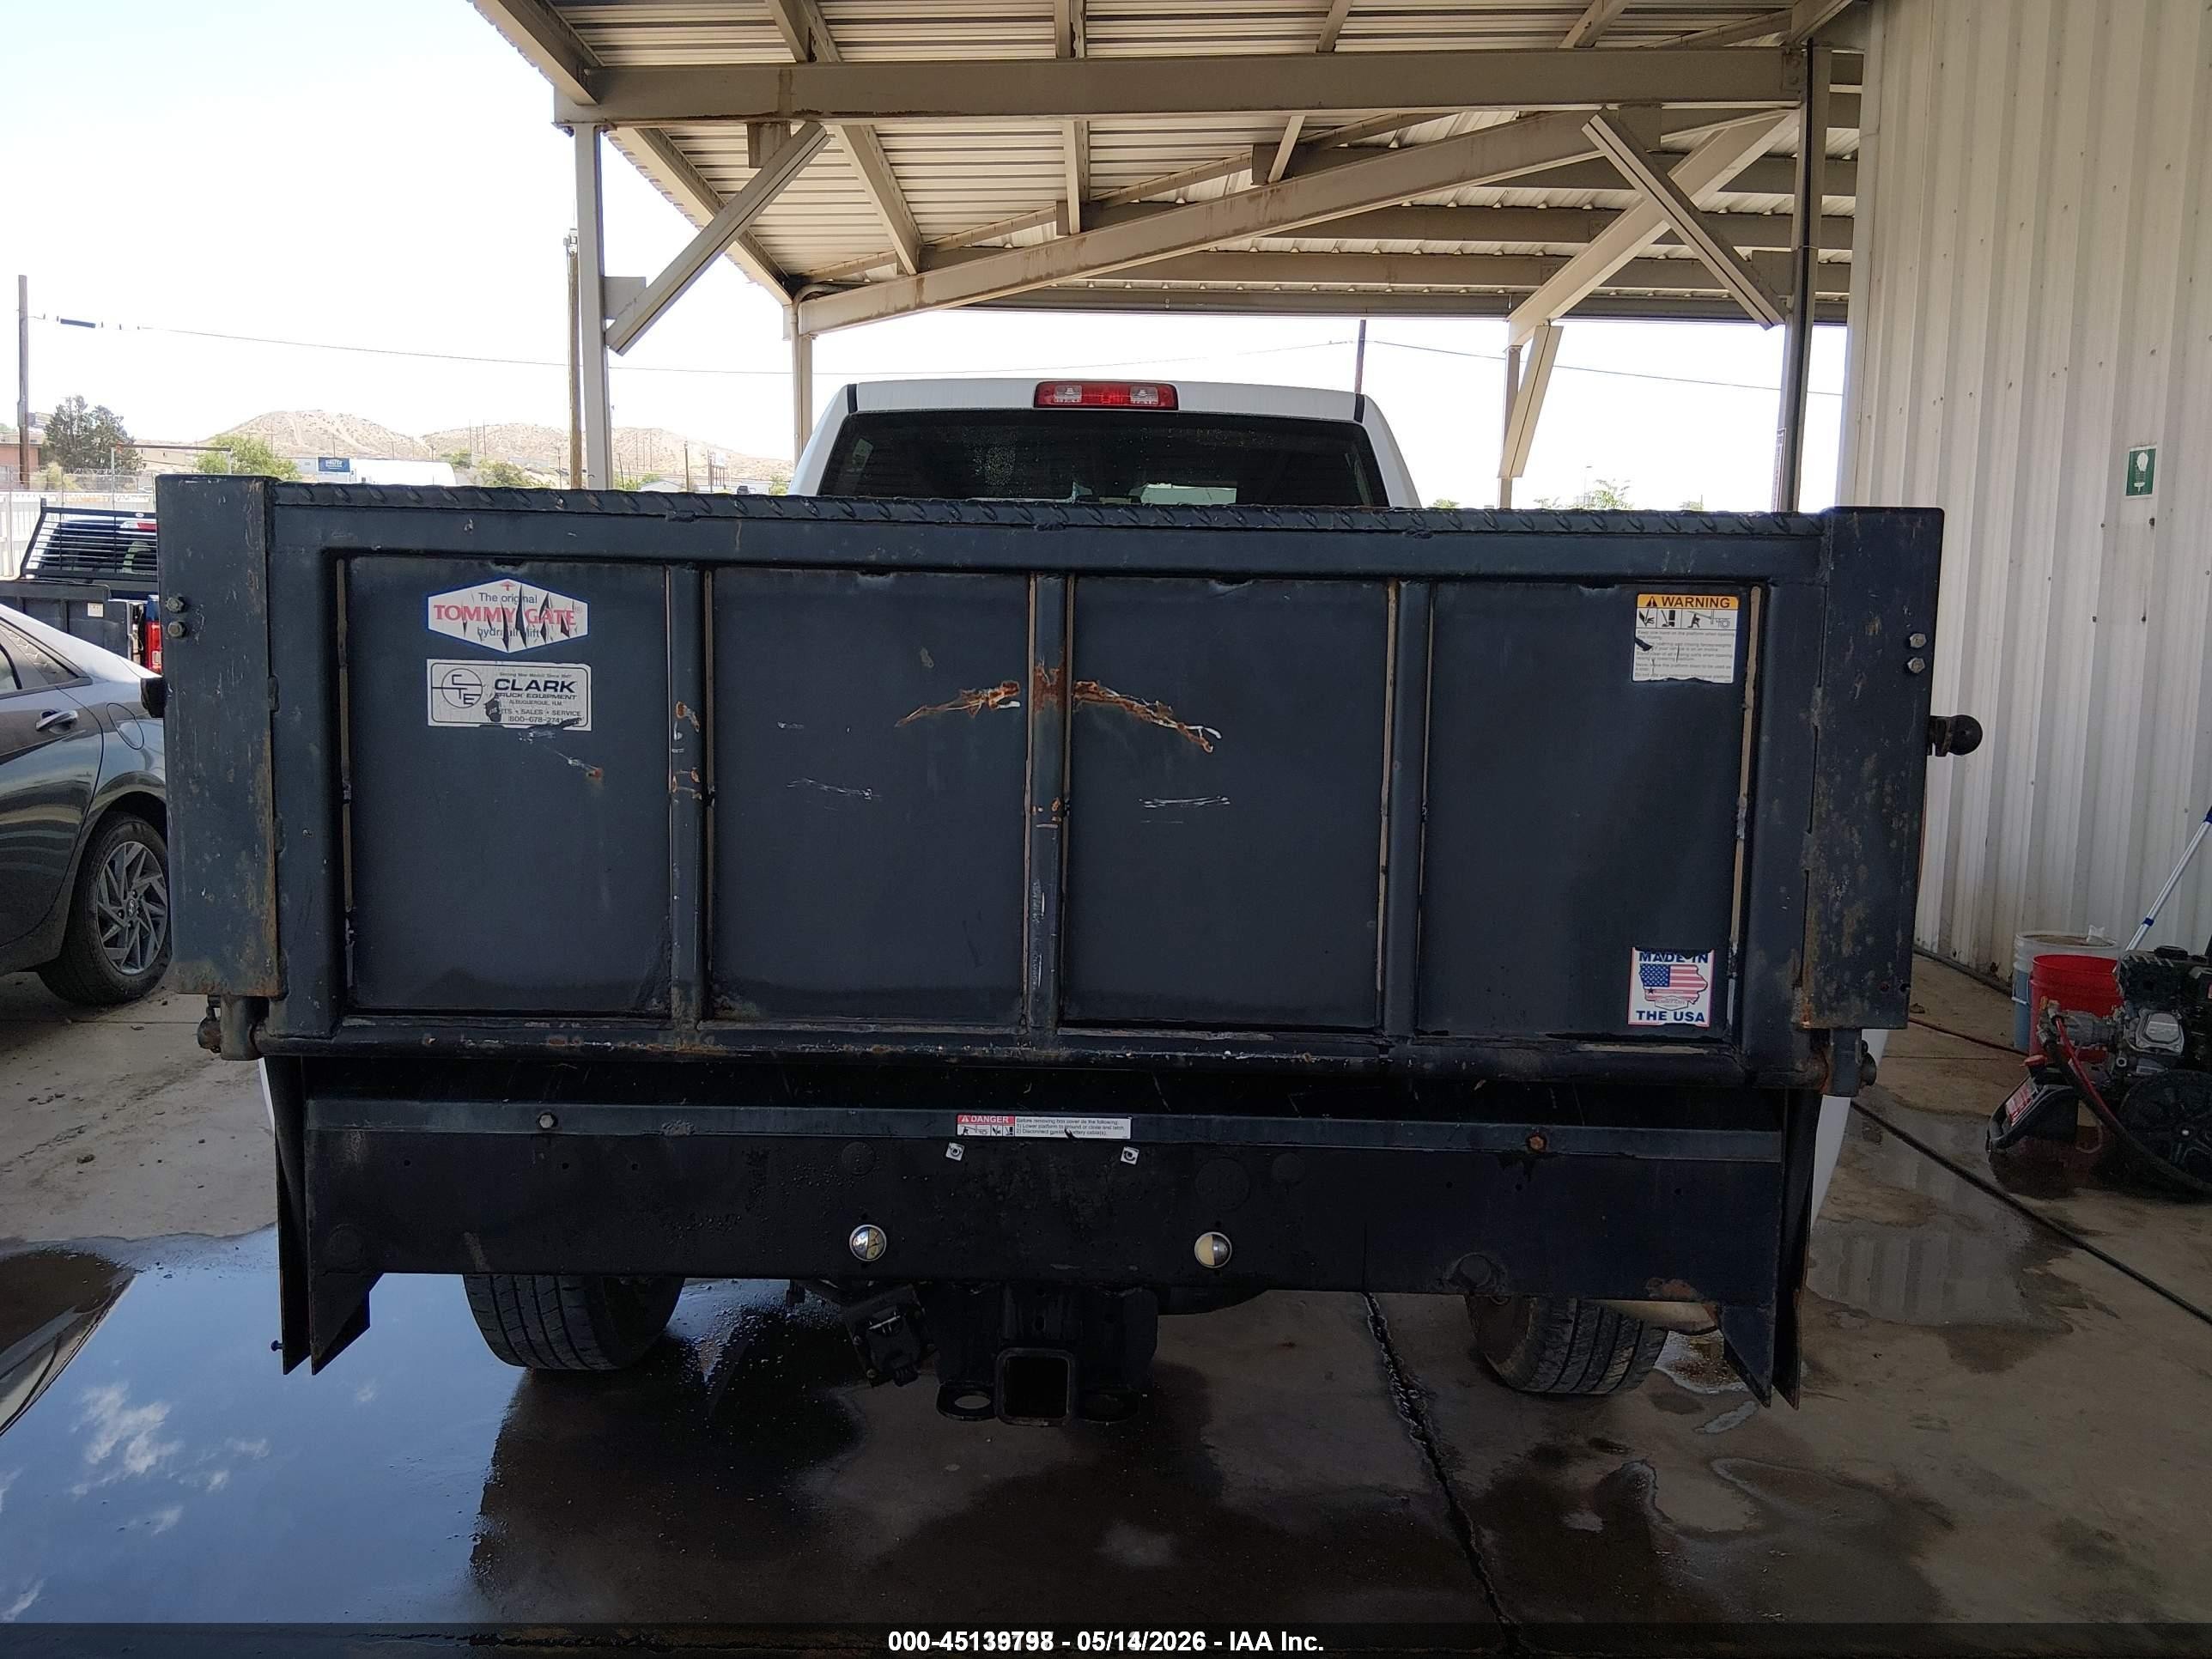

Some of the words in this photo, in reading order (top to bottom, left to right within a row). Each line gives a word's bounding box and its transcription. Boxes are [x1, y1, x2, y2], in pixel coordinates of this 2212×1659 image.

[477, 592, 498, 602] The
[501, 593, 538, 605] orignal
[1661, 596, 1730, 609] WARNING
[434, 605, 515, 623] TOMMY
[524, 608, 577, 626] GATE
[495, 678, 578, 694] CLARK
[1638, 951, 1685, 963] MADE
[1692, 952, 1708, 963] IN
[1636, 1010, 1668, 1021] THE
[1673, 1012, 1705, 1023] USA
